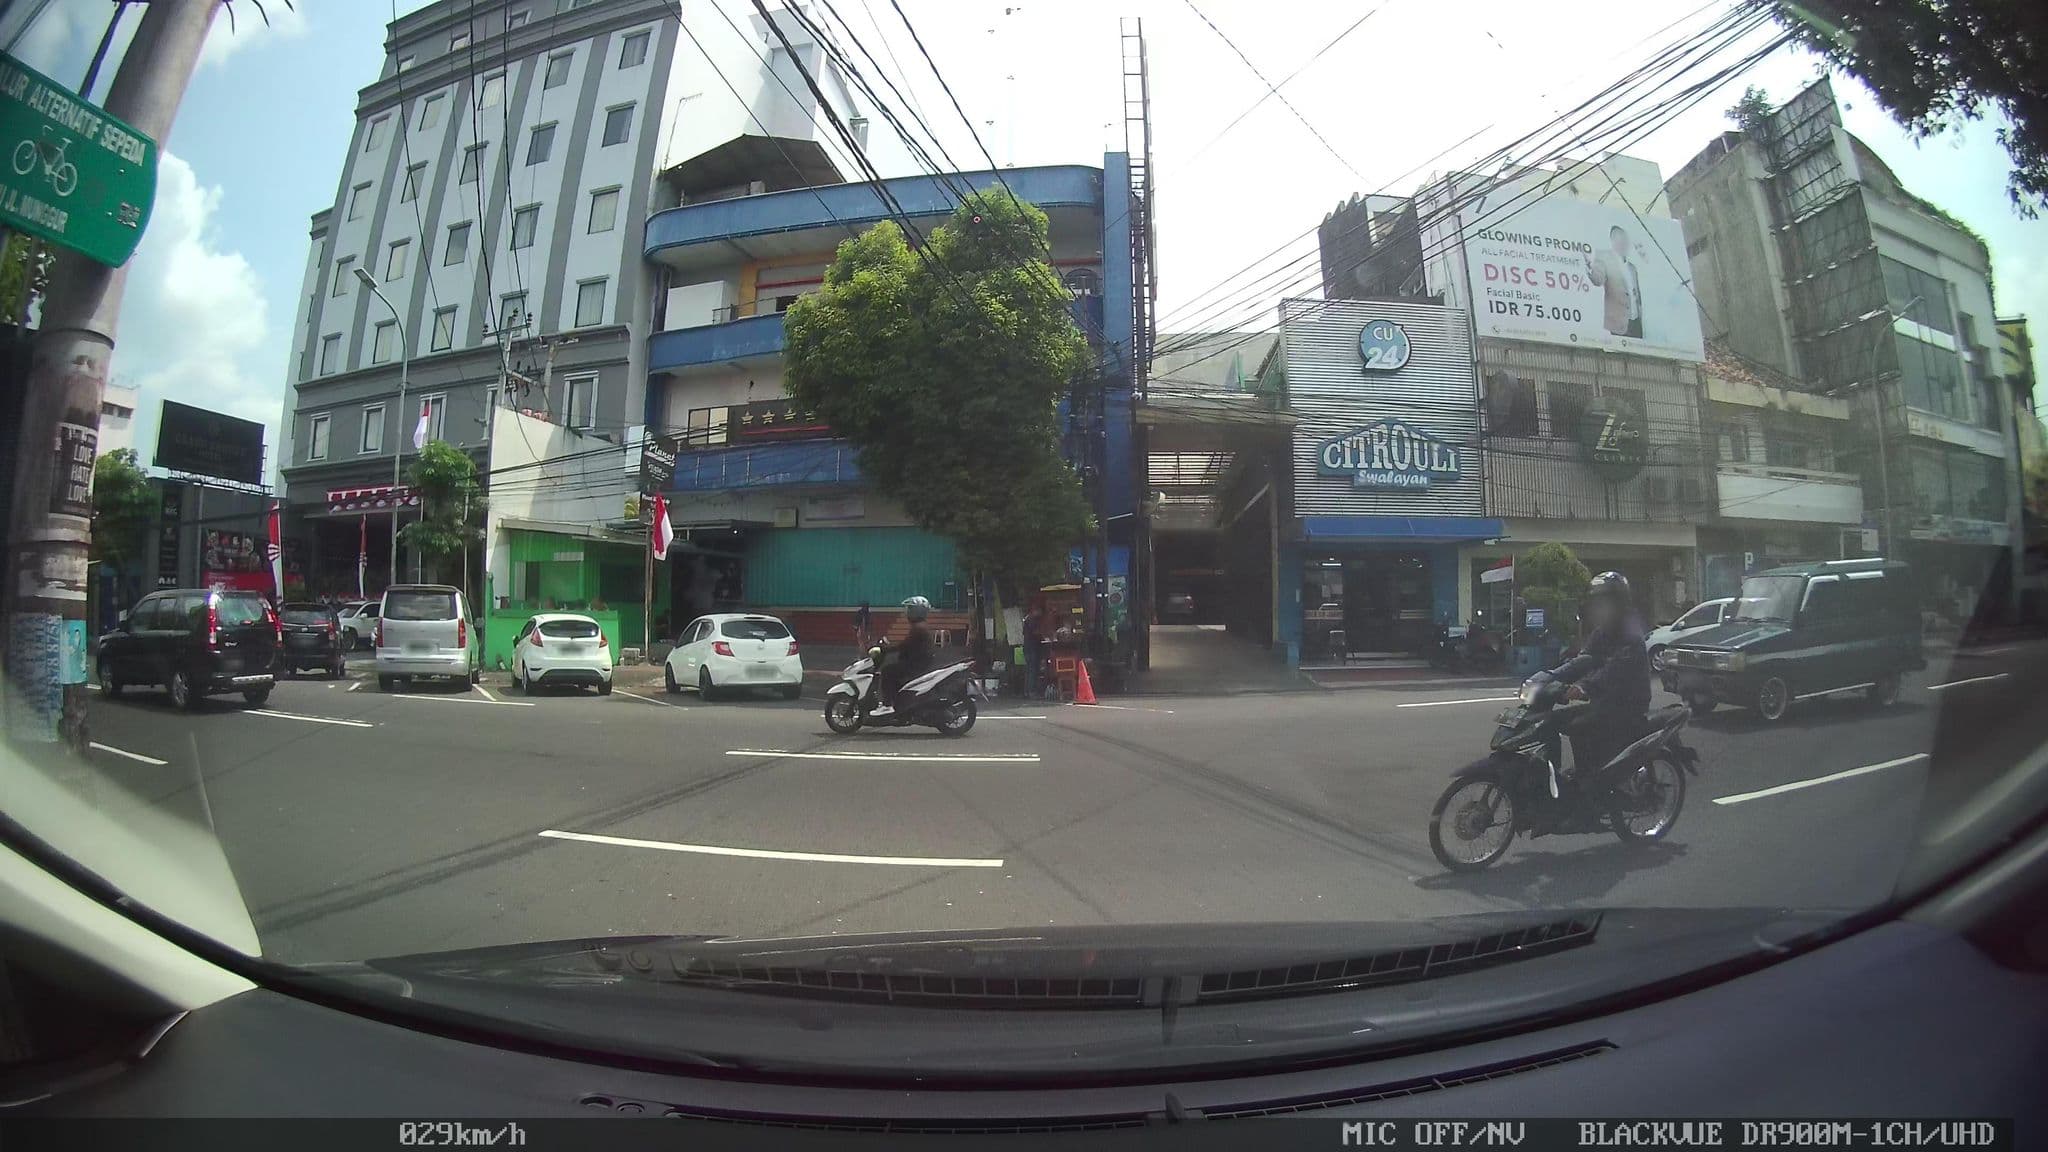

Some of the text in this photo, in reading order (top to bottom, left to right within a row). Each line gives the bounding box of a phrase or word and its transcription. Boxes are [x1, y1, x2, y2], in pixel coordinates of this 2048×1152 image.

[28, 83, 102, 139] ALTERNATIF
[100, 124, 147, 166] SEPEDA
[1479, 229, 1592, 254] GLOWING PROMO
[1481, 247, 1580, 266] ALL FACIAL TREATMENT
[1484, 263, 1590, 293] DISC 50%
[1486, 287, 1540, 301] Facial Basic
[1489, 300, 1582, 322] IDR 75.000
[1373, 326, 1394, 341] CU
[1365, 345, 1399, 369] 24
[1323, 423, 1458, 473] CITROULI
[1358, 469, 1428, 487] Swalayan
